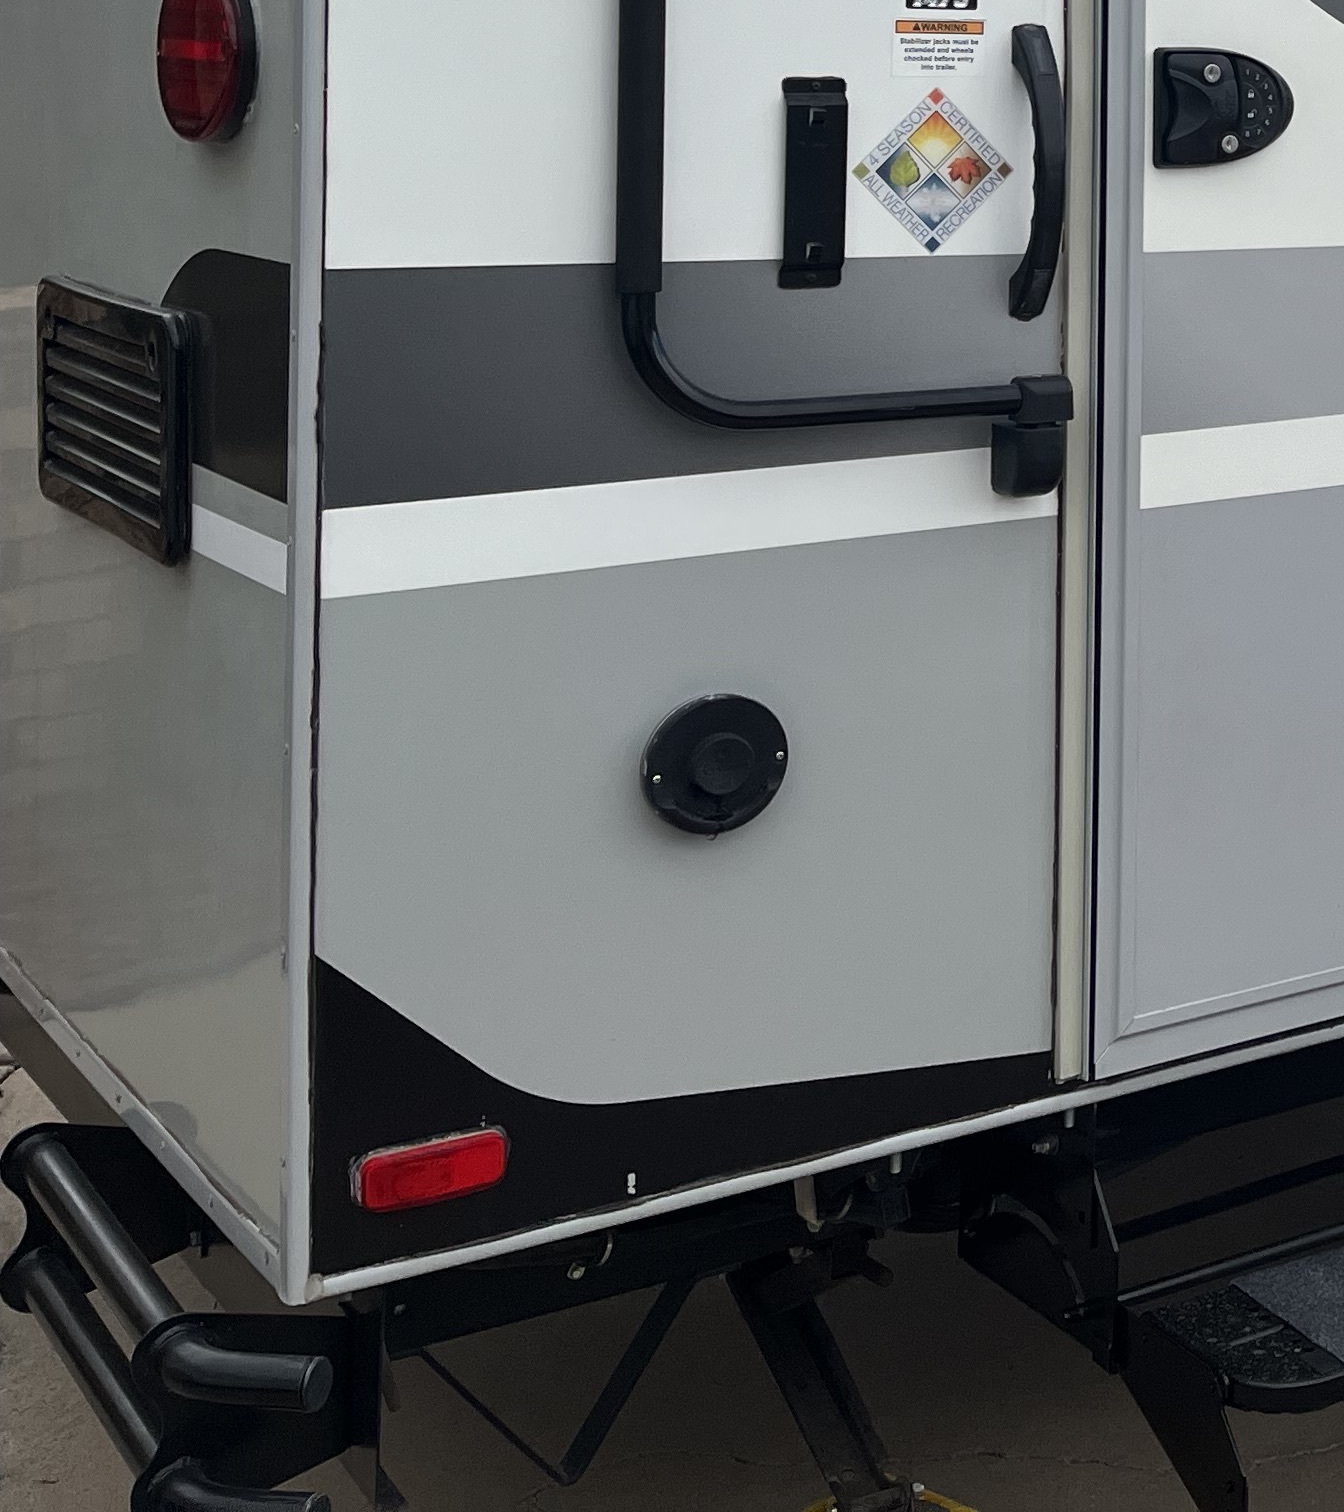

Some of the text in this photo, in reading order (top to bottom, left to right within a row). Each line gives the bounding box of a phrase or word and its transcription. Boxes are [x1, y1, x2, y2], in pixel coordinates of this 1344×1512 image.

[900, 37, 932, 45] Stabilizer
[933, 38, 950, 46] jacks
[921, 23, 968, 32] WARNING
[869, 101, 932, 166] 4 SEASON
[939, 101, 1001, 166] CERTIFIED
[863, 174, 929, 239] ALL WEATHER
[935, 172, 1002, 241] RECREATION
